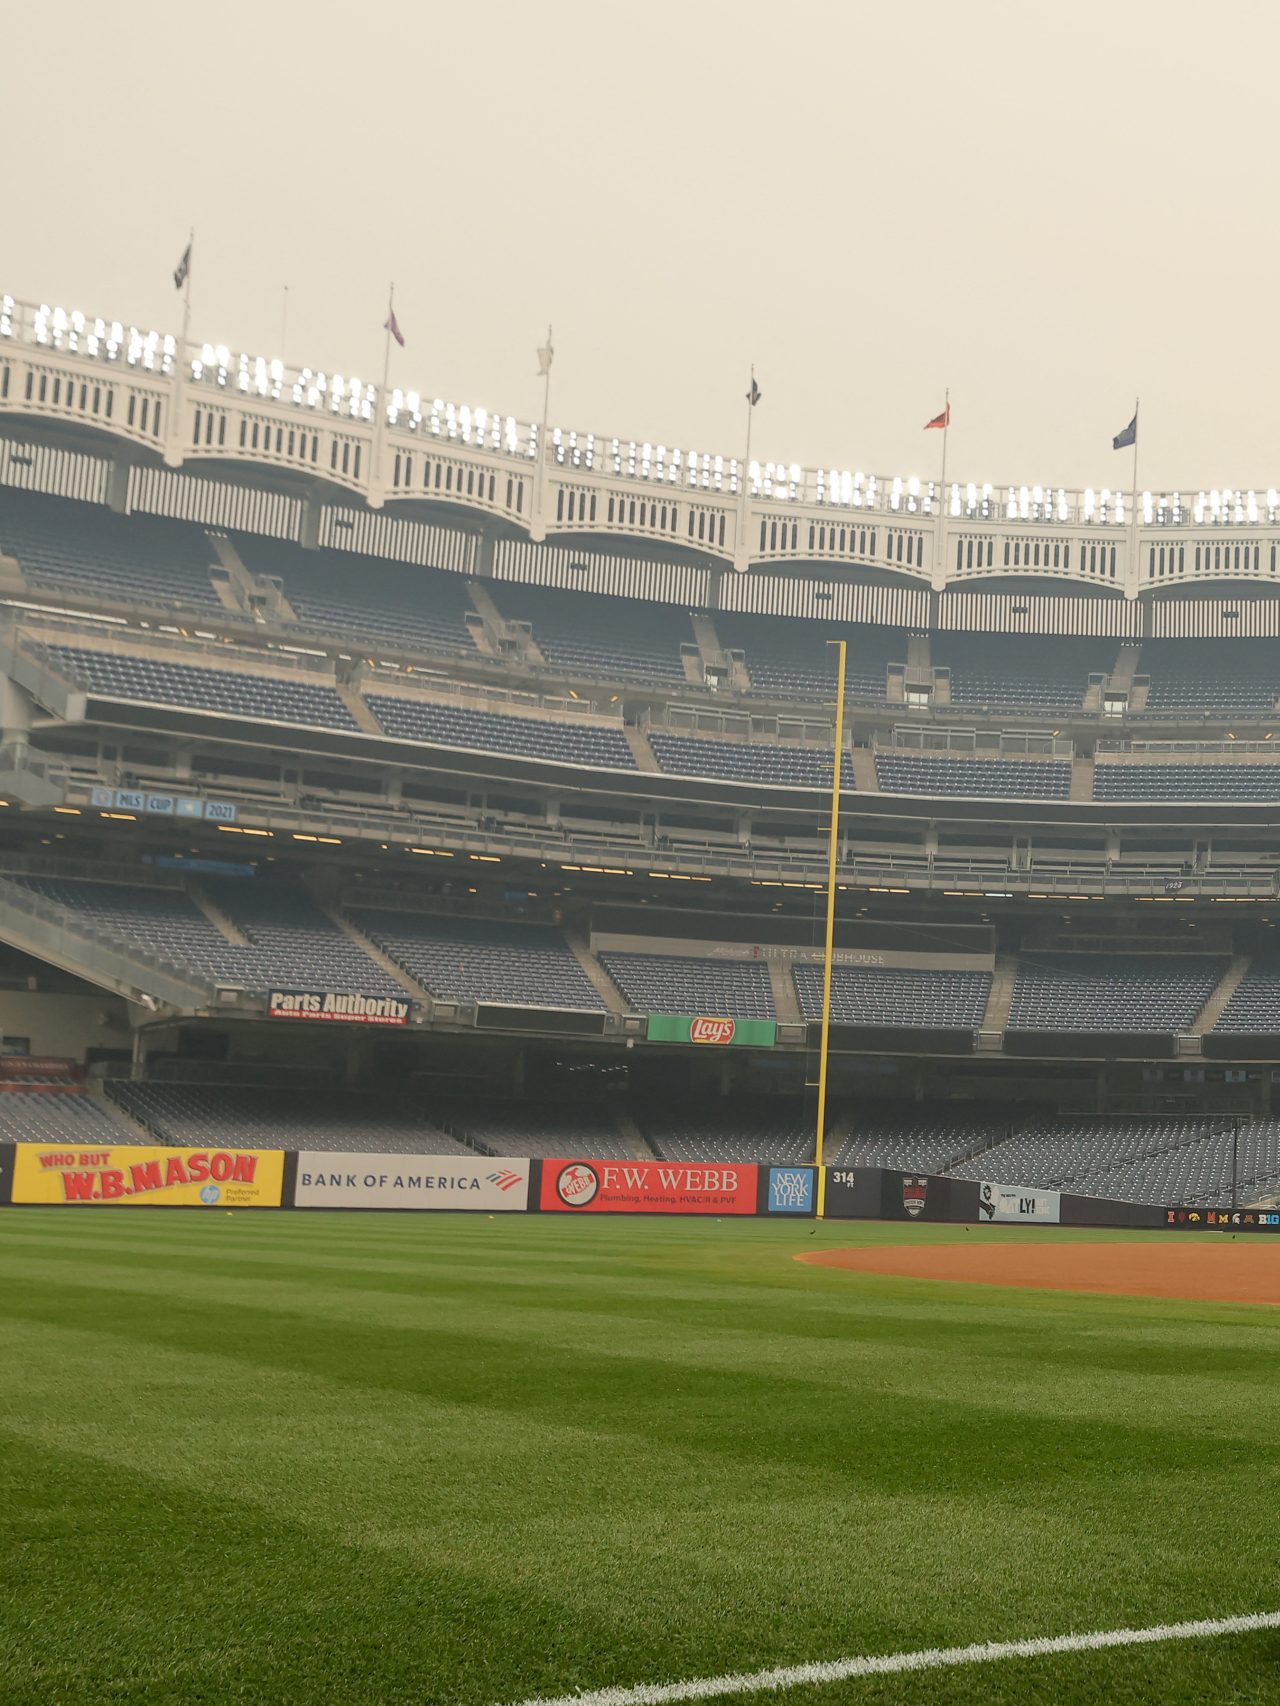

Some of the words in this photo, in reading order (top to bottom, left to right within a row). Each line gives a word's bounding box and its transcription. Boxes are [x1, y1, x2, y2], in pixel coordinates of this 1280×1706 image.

[149, 798, 171, 810] CUP
[270, 992, 321, 1011] Parts
[323, 993, 408, 1018] Authority
[694, 1019, 733, 1040] Lay's
[40, 1153, 75, 1168] WHO
[80, 1152, 110, 1166] BUT
[302, 1173, 358, 1187] BANK
[364, 1175, 388, 1187] OF
[393, 1176, 481, 1190] AMERICA
[603, 1167, 649, 1189] F.W.
[657, 1169, 738, 1192] WEBB
[776, 1173, 806, 1185] NEW
[833, 1172, 854, 1183] 314
[566, 1176, 590, 1196] WEBB
[772, 1183, 808, 1196] YORK
[776, 1194, 804, 1206] LIFE
